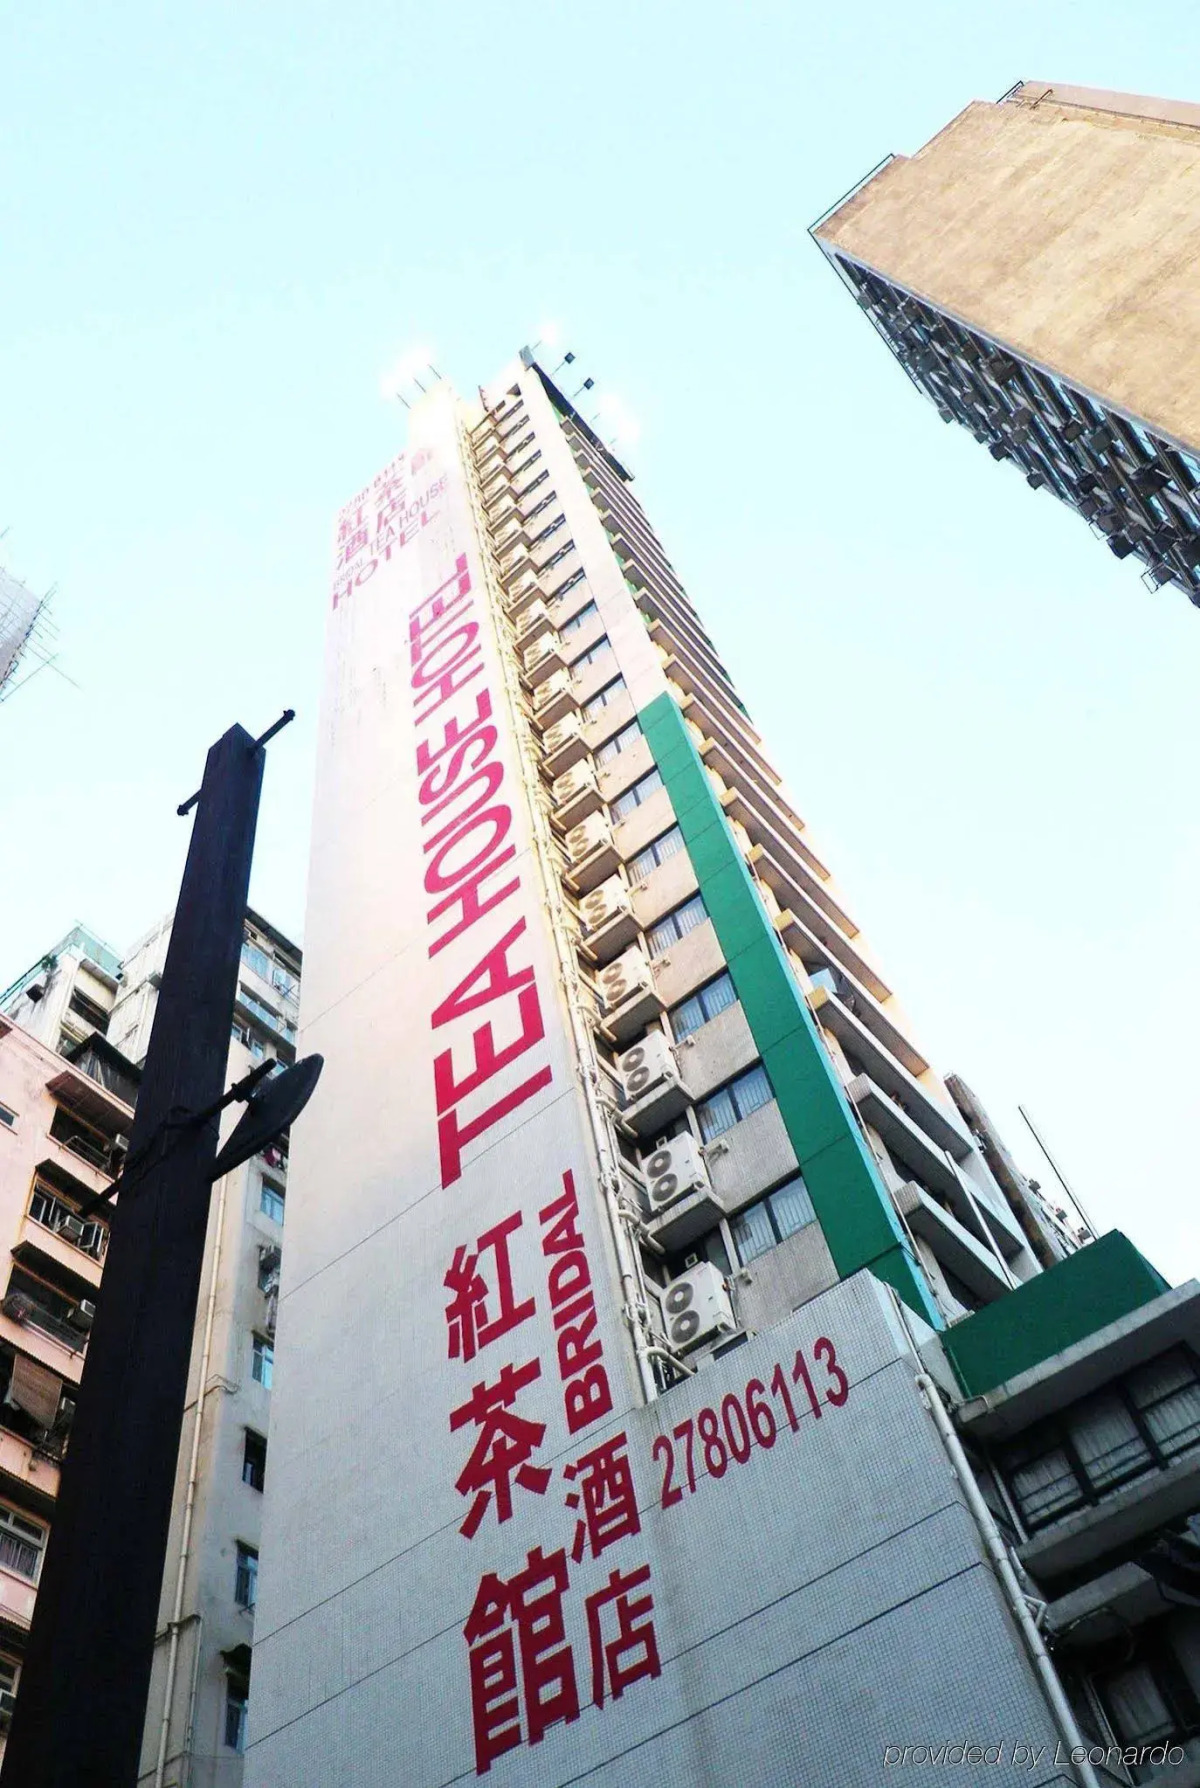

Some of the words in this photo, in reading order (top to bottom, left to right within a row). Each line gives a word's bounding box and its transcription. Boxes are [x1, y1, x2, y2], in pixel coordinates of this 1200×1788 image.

[332, 509, 442, 611] HOTEL
[368, 524, 396, 556] TEA
[399, 473, 449, 527] HOUSE
[409, 552, 484, 727] HOTEL
[415, 687, 521, 959] HOUSE
[431, 915, 553, 1190] TEA
[538, 1168, 613, 1435] BRIDAL
[652, 1336, 850, 1510] 27806113
[442, 1209, 582, 1775] 紅茶館
[563, 1432, 662, 1710] 酒店
